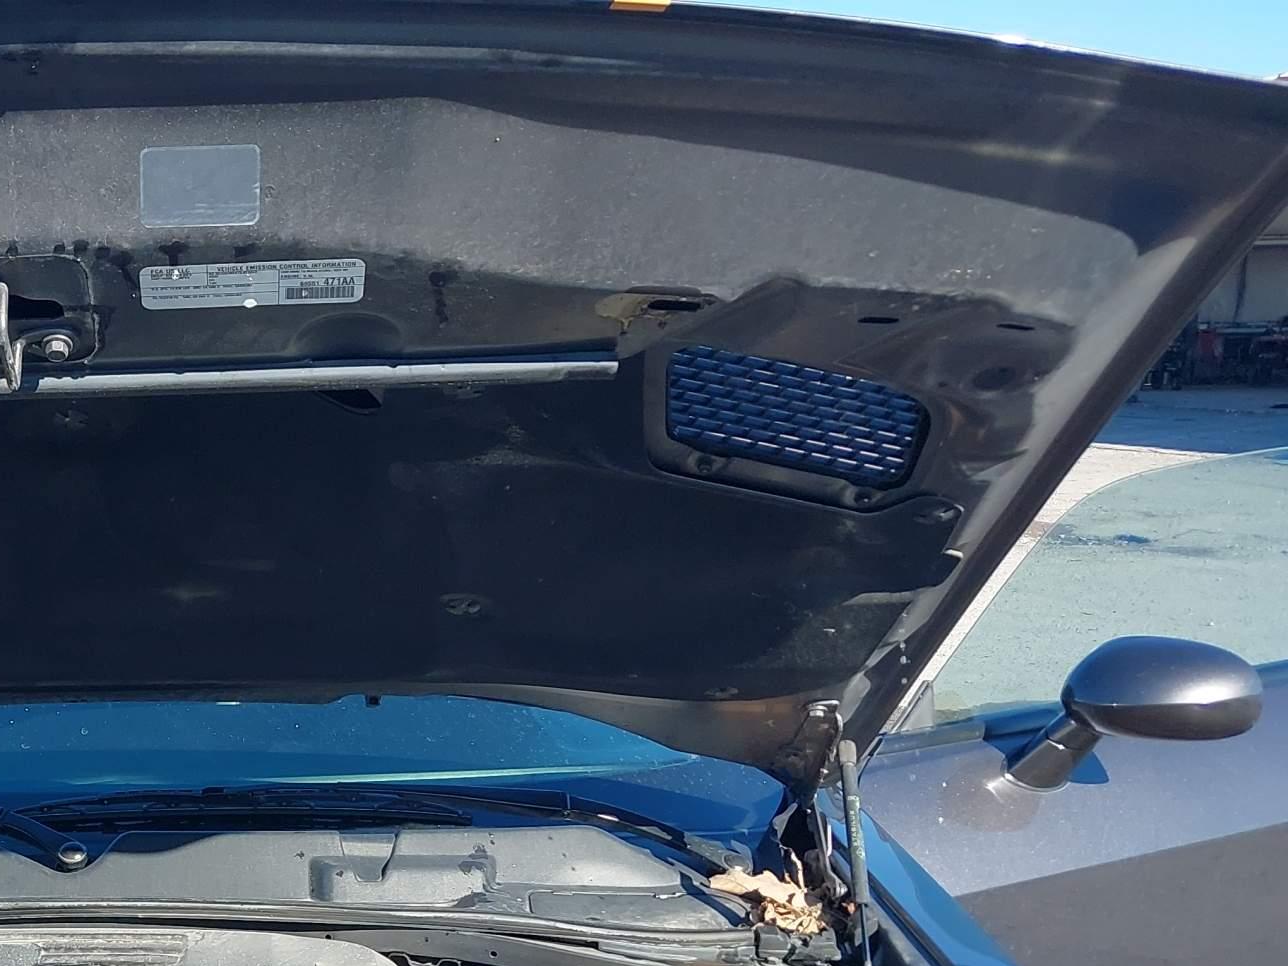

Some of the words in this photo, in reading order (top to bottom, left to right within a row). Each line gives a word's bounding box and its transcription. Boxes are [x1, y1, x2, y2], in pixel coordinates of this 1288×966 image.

[216, 265, 244, 273] VEHICLE
[245, 263, 278, 272] EMISSION
[279, 262, 307, 270] CONTROL
[311, 261, 357, 269] INFORMATION
[324, 276, 356, 286] 471AA
